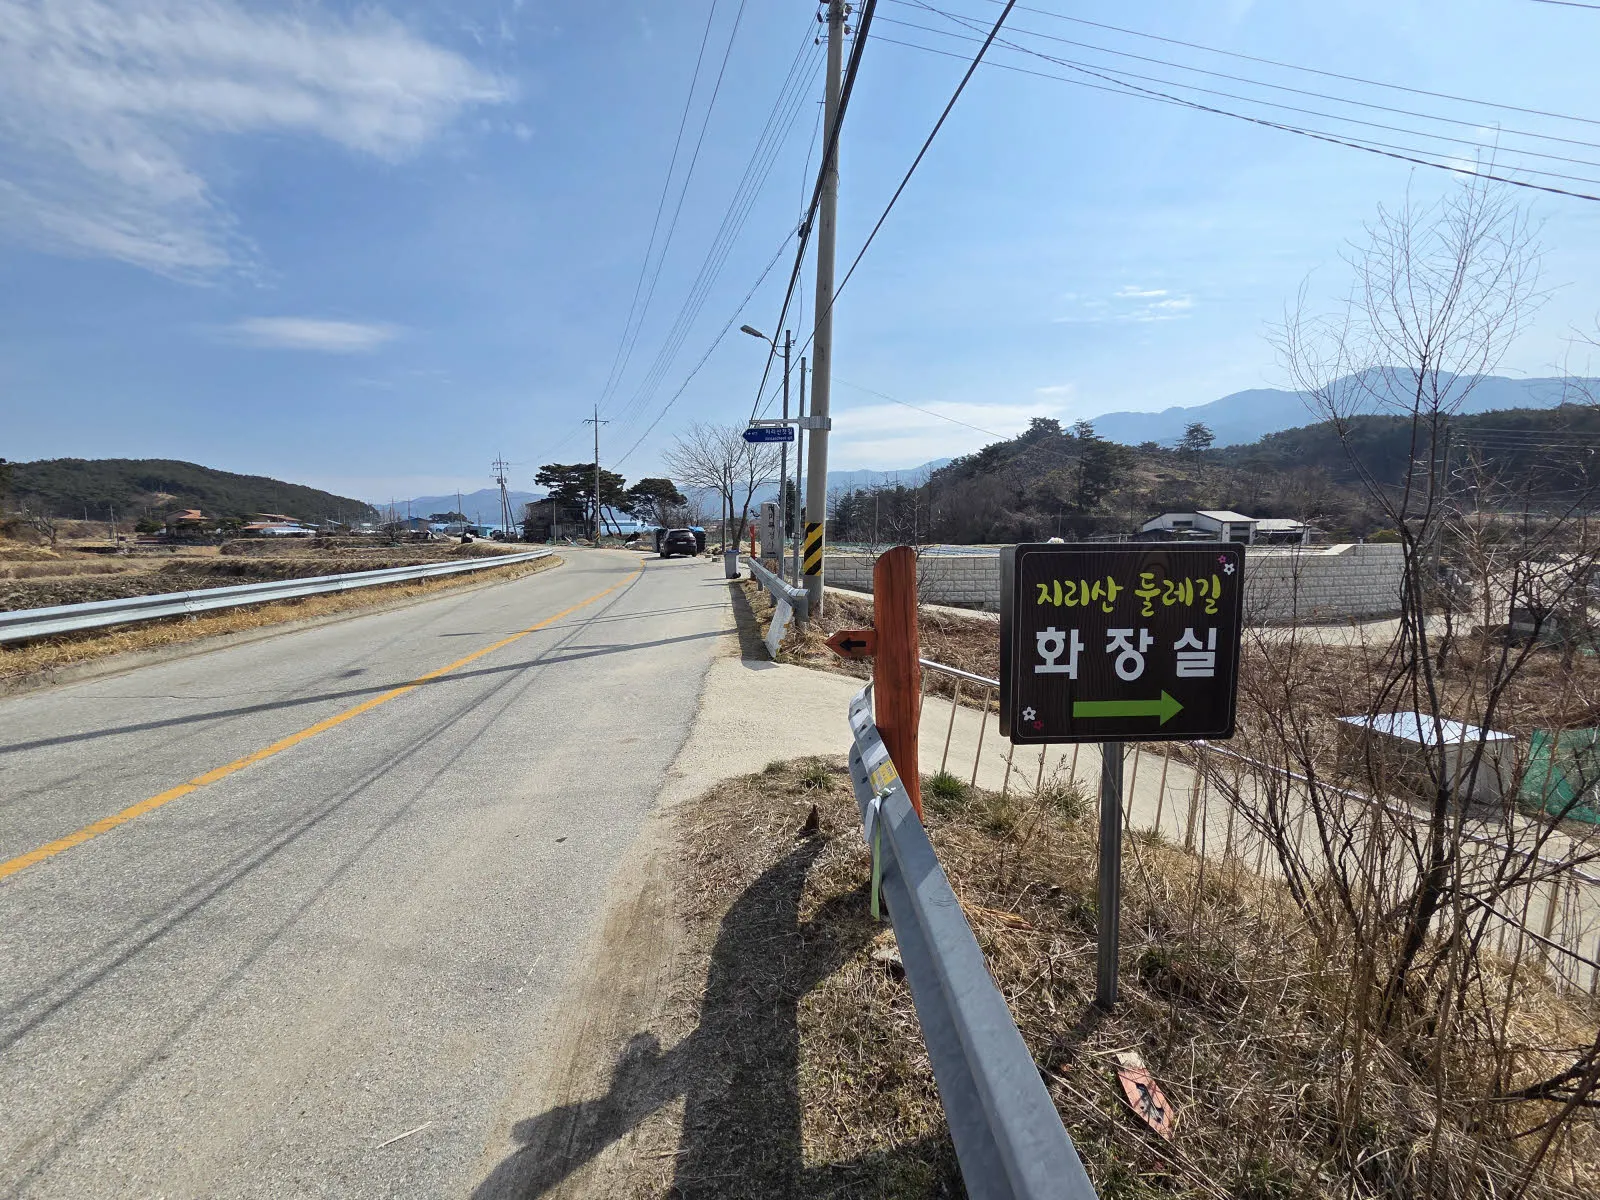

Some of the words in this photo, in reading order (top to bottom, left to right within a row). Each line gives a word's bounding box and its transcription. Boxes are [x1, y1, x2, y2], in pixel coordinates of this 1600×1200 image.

[1036, 575, 1124, 614] 지리산
[1134, 572, 1222, 617] 둘레길
[1034, 626, 1218, 681] 화장실
